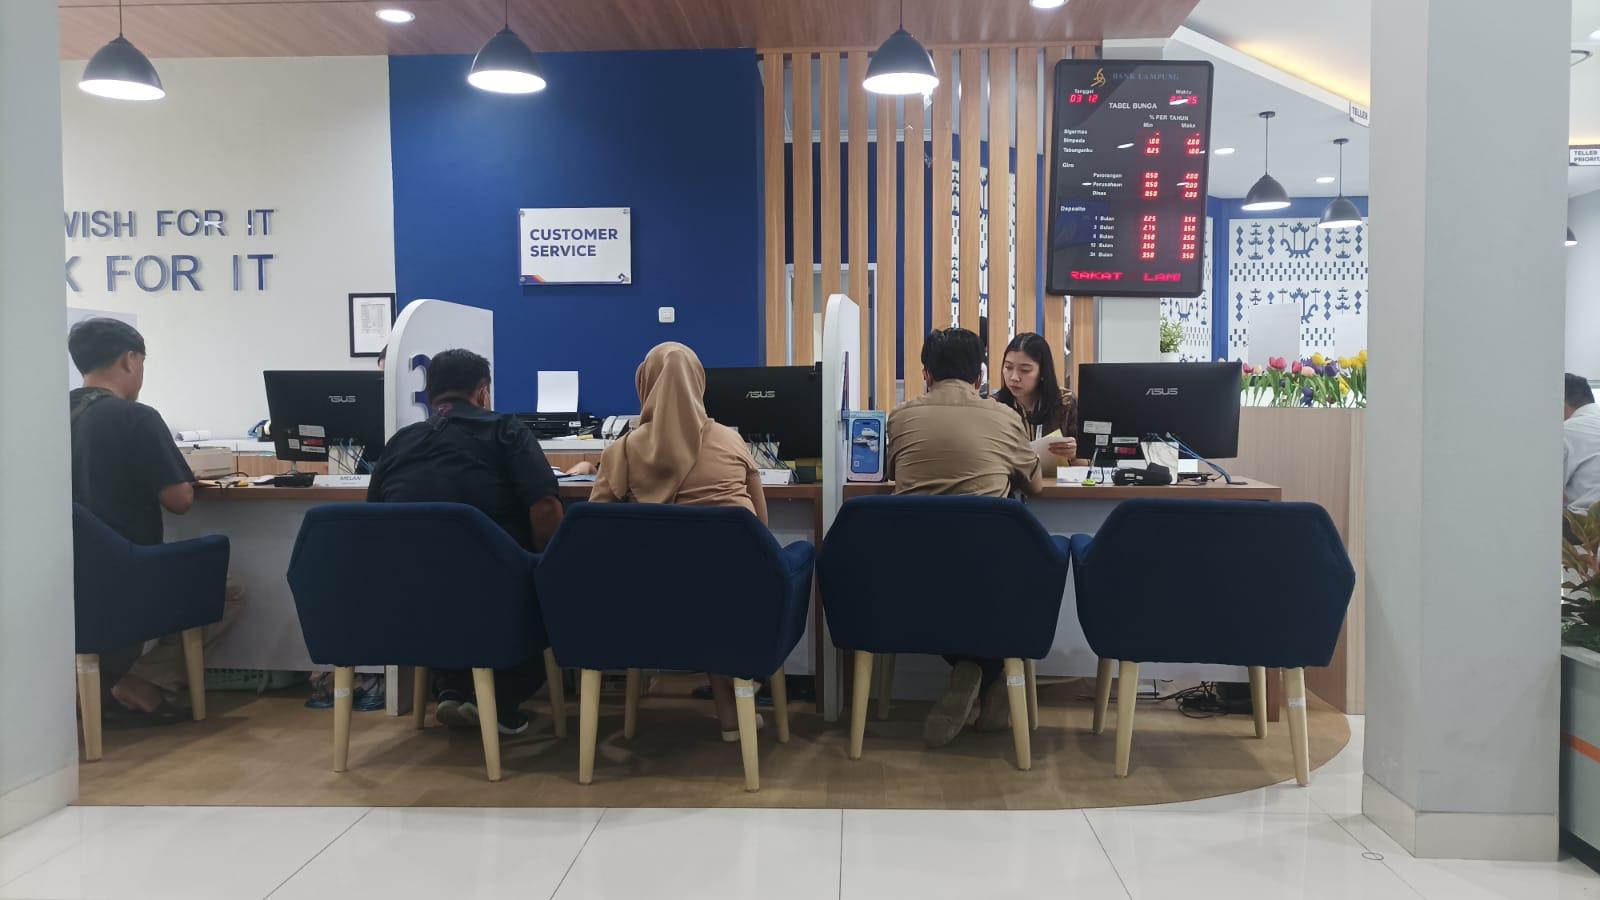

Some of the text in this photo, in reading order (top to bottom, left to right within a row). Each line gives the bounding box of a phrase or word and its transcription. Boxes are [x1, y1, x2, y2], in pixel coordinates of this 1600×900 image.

[1070, 94, 1081, 103] 03
[1352, 106, 1368, 120] TELLER
[156, 209, 227, 237] FOR
[247, 209, 275, 236] IT
[530, 228, 618, 240] CUSTOMER
[530, 245, 596, 257] SERVICE
[106, 254, 203, 293] FOR
[232, 254, 274, 292] IT
[745, 390, 776, 399] ASUS
[1145, 387, 1178, 396] ASUS
[328, 395, 356, 403] ASUS
